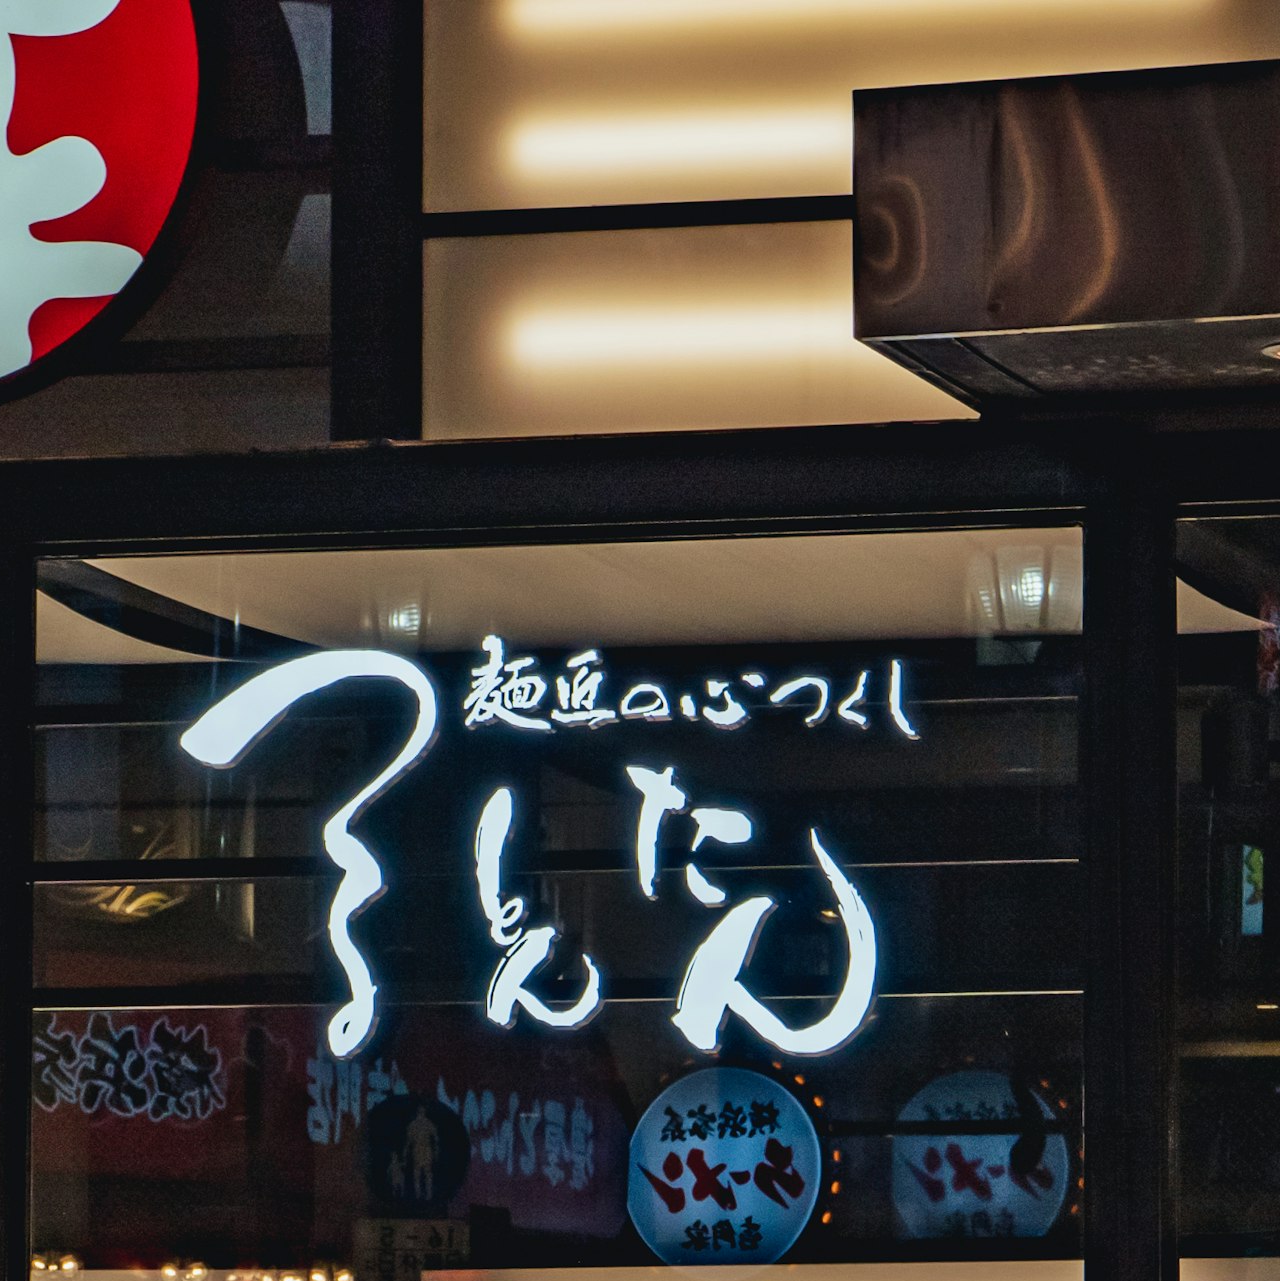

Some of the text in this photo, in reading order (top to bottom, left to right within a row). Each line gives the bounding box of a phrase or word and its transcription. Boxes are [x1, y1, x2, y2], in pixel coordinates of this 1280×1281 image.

[461, 633, 921, 740] 麺匠の心つくし
